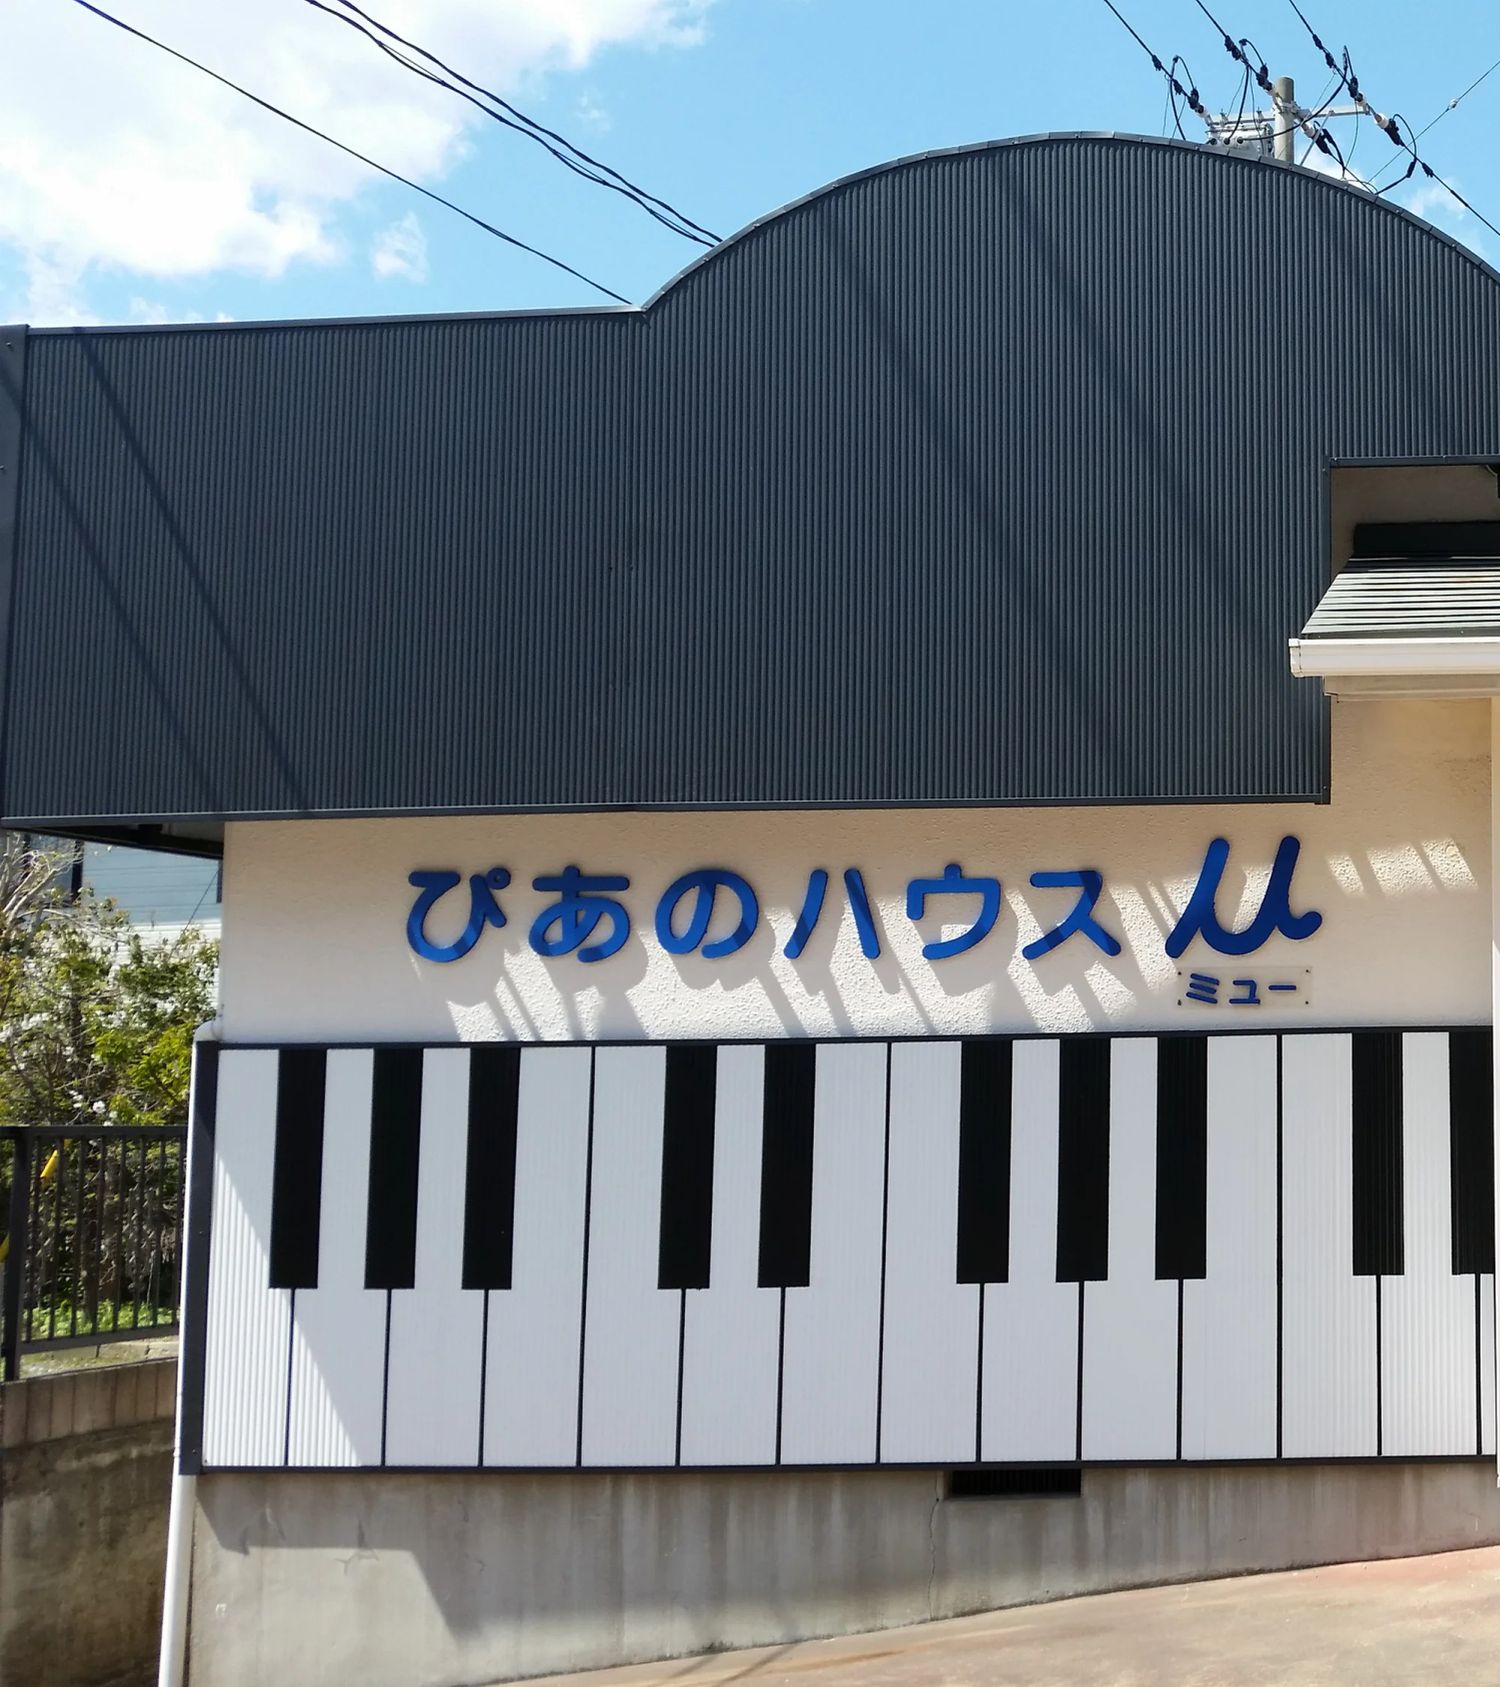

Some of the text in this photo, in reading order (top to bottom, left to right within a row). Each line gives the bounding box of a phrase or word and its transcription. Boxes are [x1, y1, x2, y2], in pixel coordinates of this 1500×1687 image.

[406, 864, 1122, 963] ぴあのハウス
[1185, 972, 1298, 1005] ミュー
